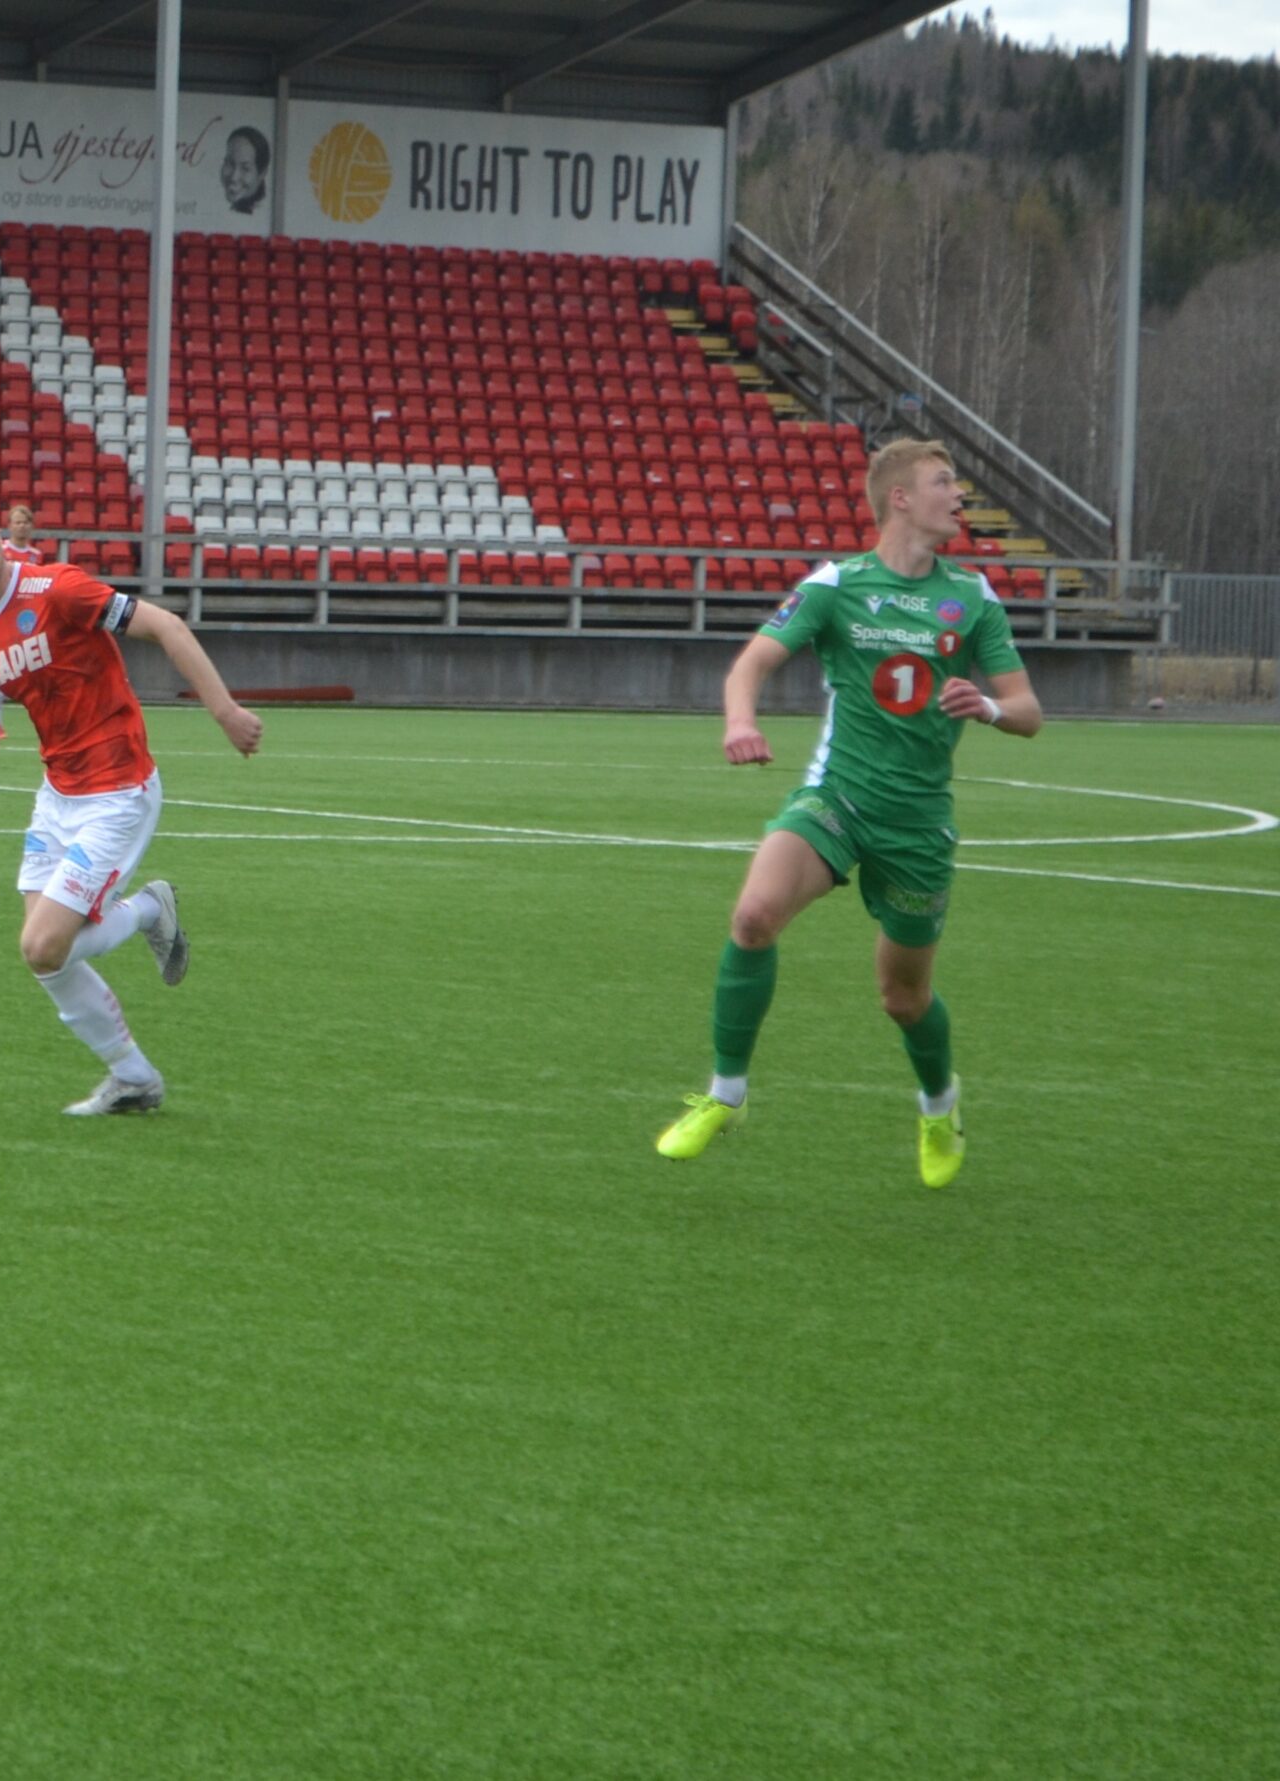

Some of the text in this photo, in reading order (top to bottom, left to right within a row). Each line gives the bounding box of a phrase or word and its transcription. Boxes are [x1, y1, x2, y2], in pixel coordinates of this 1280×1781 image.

[19, 116, 223, 189] gjestegrd
[2, 192, 21, 208] og
[25, 191, 62, 207] store
[409, 141, 700, 226] RIGHT TO PLAY
[851, 623, 936, 645] SpareBank
[944, 635, 955, 652] 1
[892, 665, 915, 704] 1
